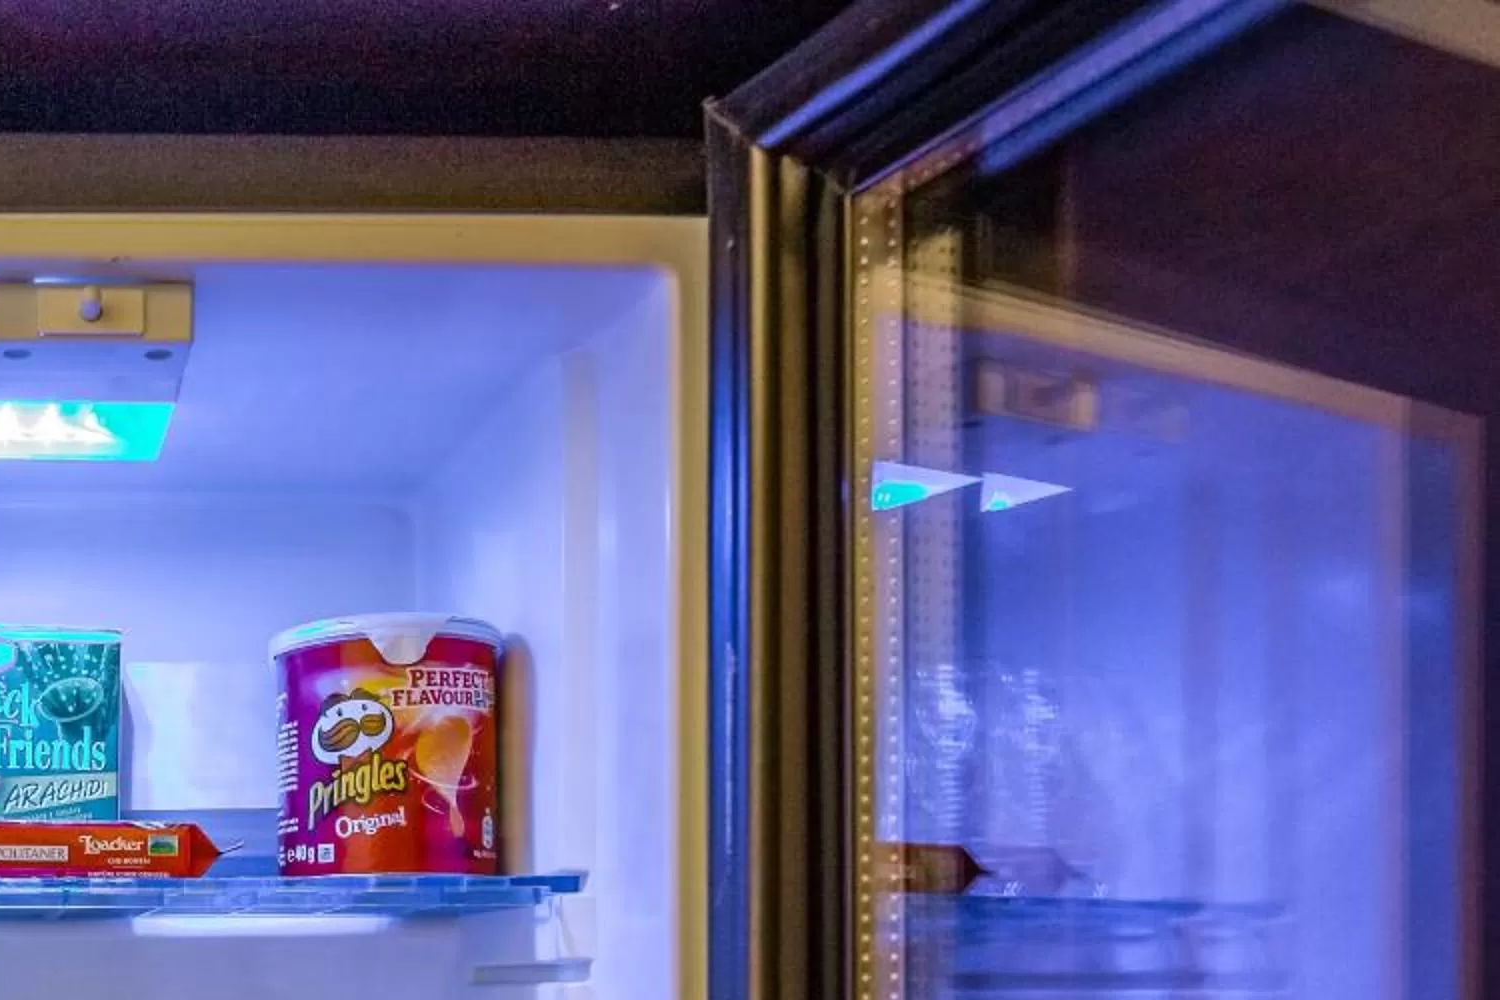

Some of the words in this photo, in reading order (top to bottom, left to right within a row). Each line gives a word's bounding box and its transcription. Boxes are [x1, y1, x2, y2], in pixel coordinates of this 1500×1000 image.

[408, 668, 488, 689] PERFECT
[3, 778, 108, 813] ARACHIDI
[307, 754, 408, 831] Pringles
[335, 806, 407, 838] Original
[79, 835, 145, 855] Loacker
